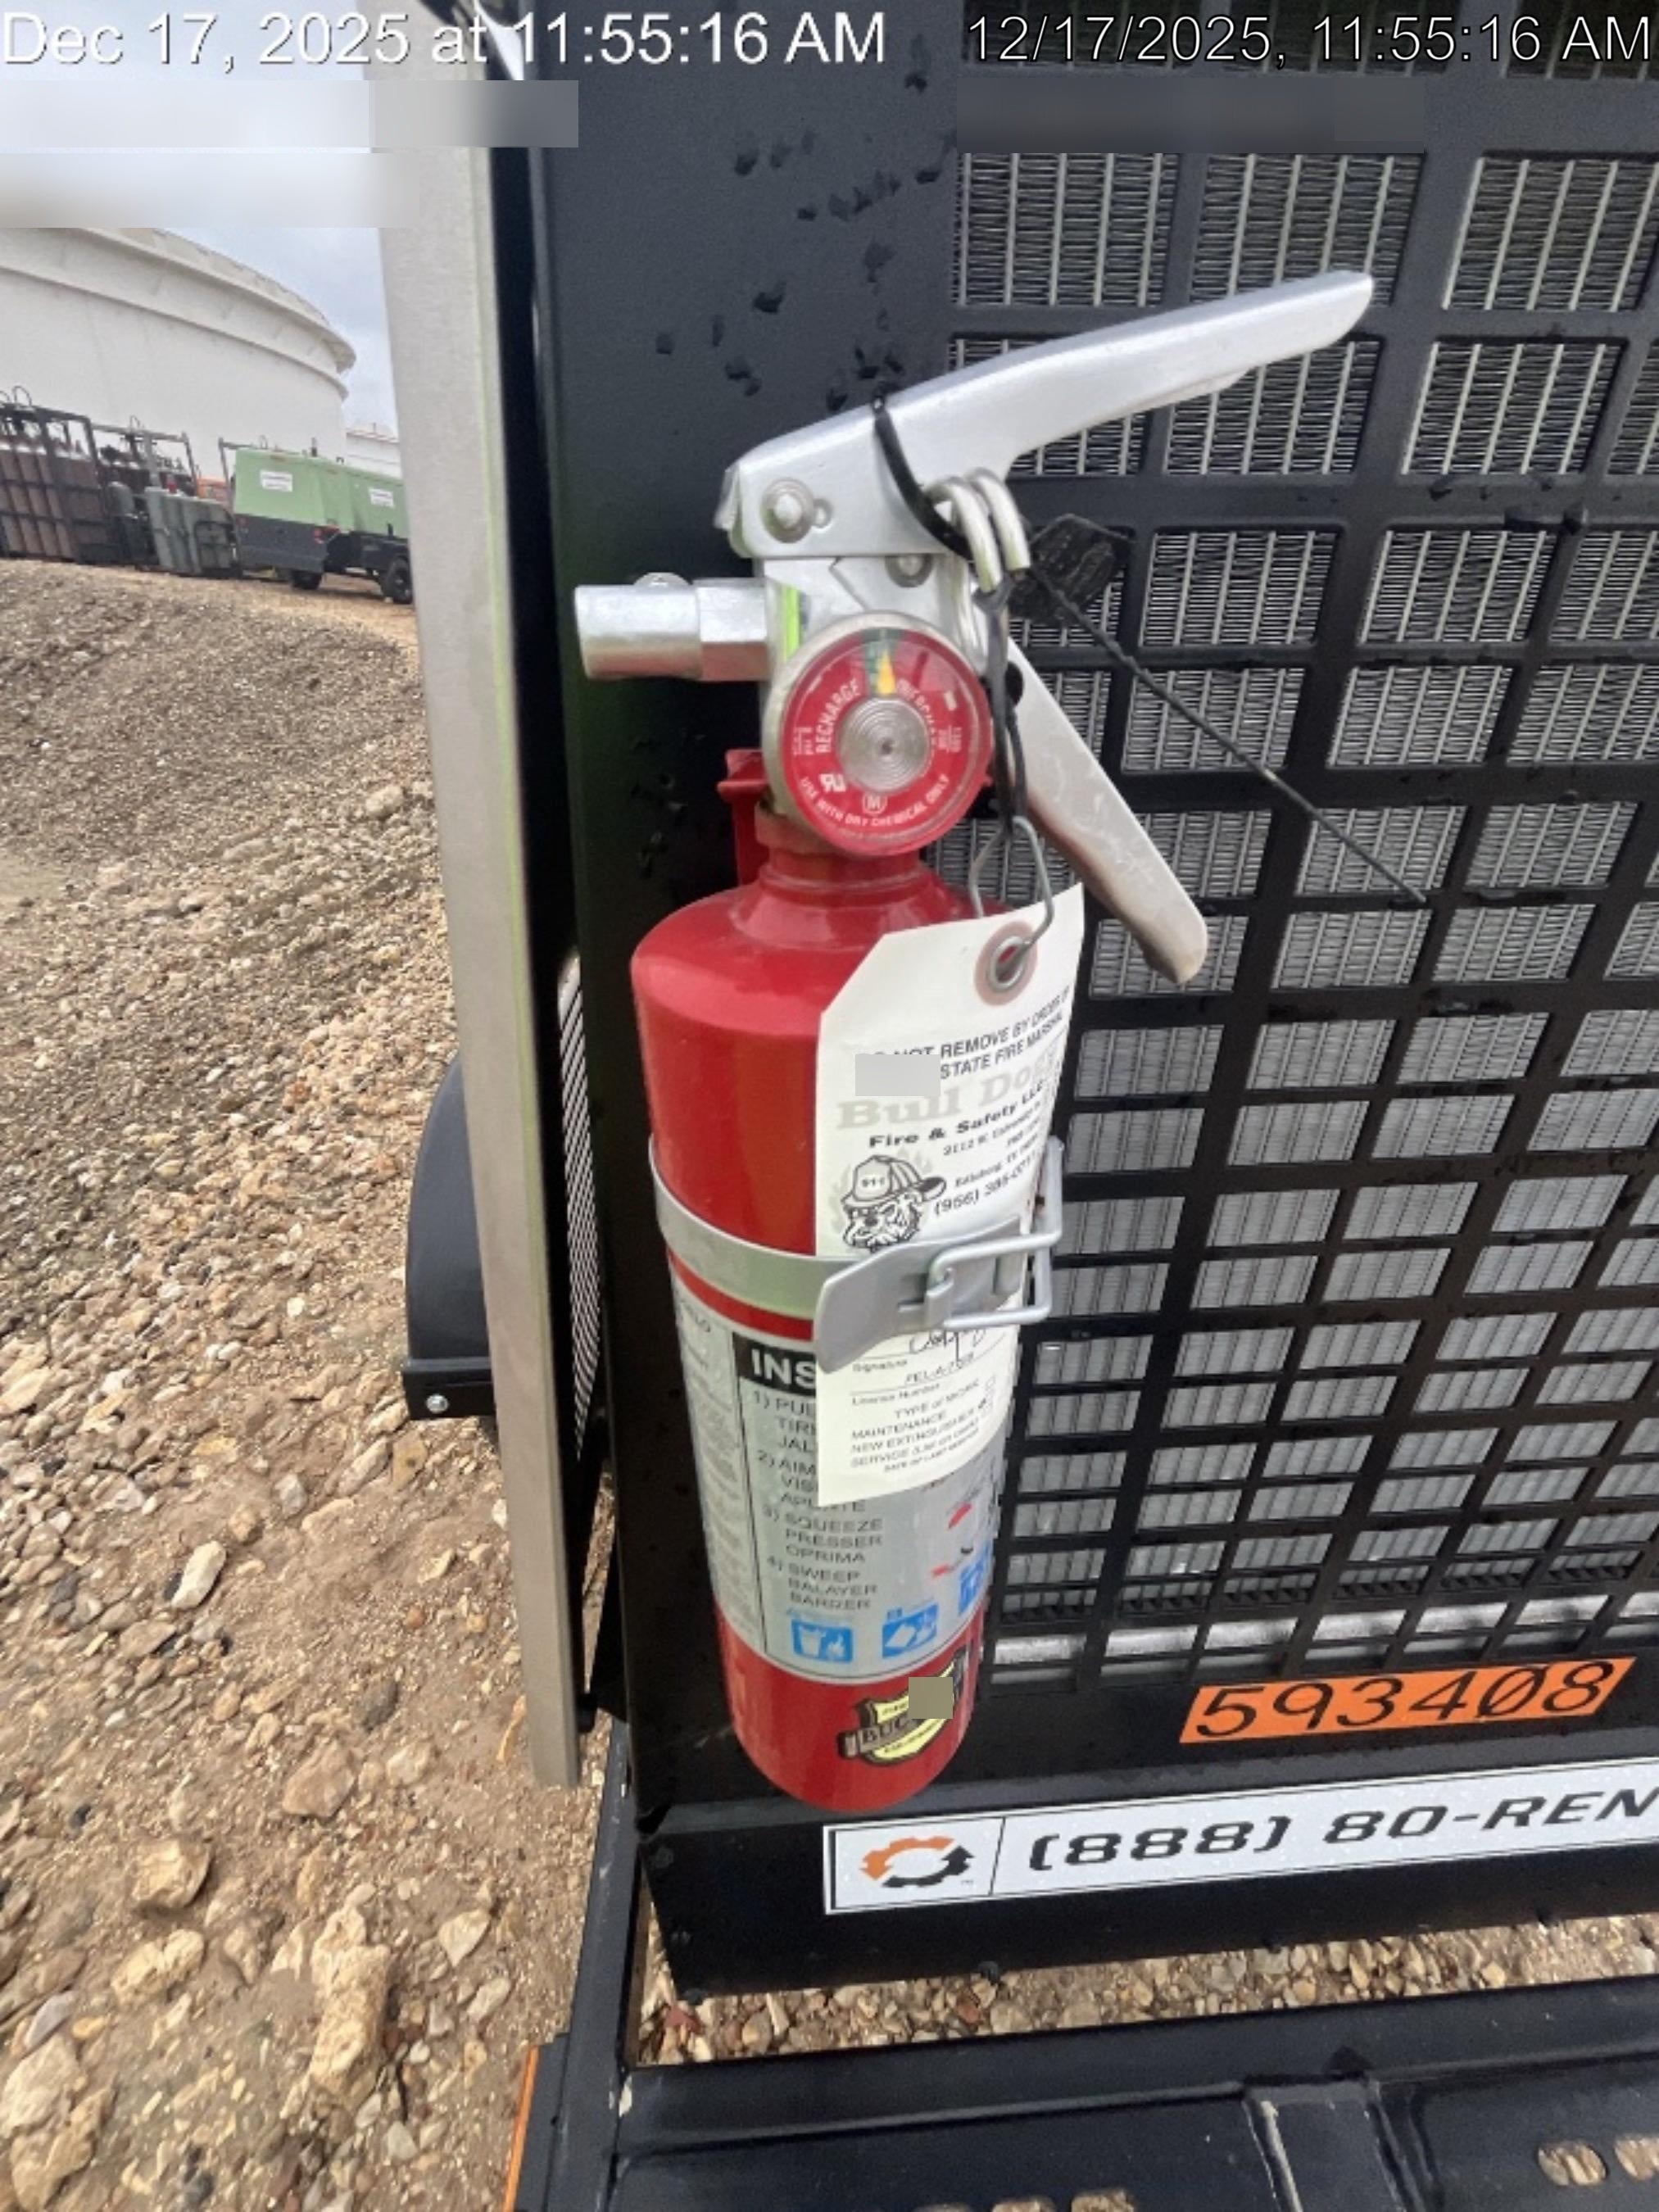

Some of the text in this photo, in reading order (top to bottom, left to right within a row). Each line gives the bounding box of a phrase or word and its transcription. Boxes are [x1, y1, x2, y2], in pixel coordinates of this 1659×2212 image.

[941, 1027, 1009, 1058] REMOVE
[1012, 1017, 1031, 1037] BY
[941, 1054, 990, 1080] STATE
[995, 1038, 1024, 1065] FIRE
[836, 1085, 962, 1130] Bull
[868, 1133, 919, 1149] Fire
[928, 1127, 946, 1141] &
[956, 1102, 1019, 1135] Safety
[751, 1349, 816, 1389] INS
[852, 1411, 946, 1439] MAINTENANCE
[895, 1403, 929, 1419] TYPE
[852, 1442, 883, 1453] NEW
[786, 1512, 883, 1533] SQUEEZE
[786, 1528, 884, 1548] PRESSER
[786, 1544, 866, 1564] OPRIMA
[789, 1562, 860, 1583] SWEEP
[788, 1577, 878, 1597] BALAYER
[1196, 1661, 1614, 1736] 593408
[1029, 1815, 1291, 1870] (888)
